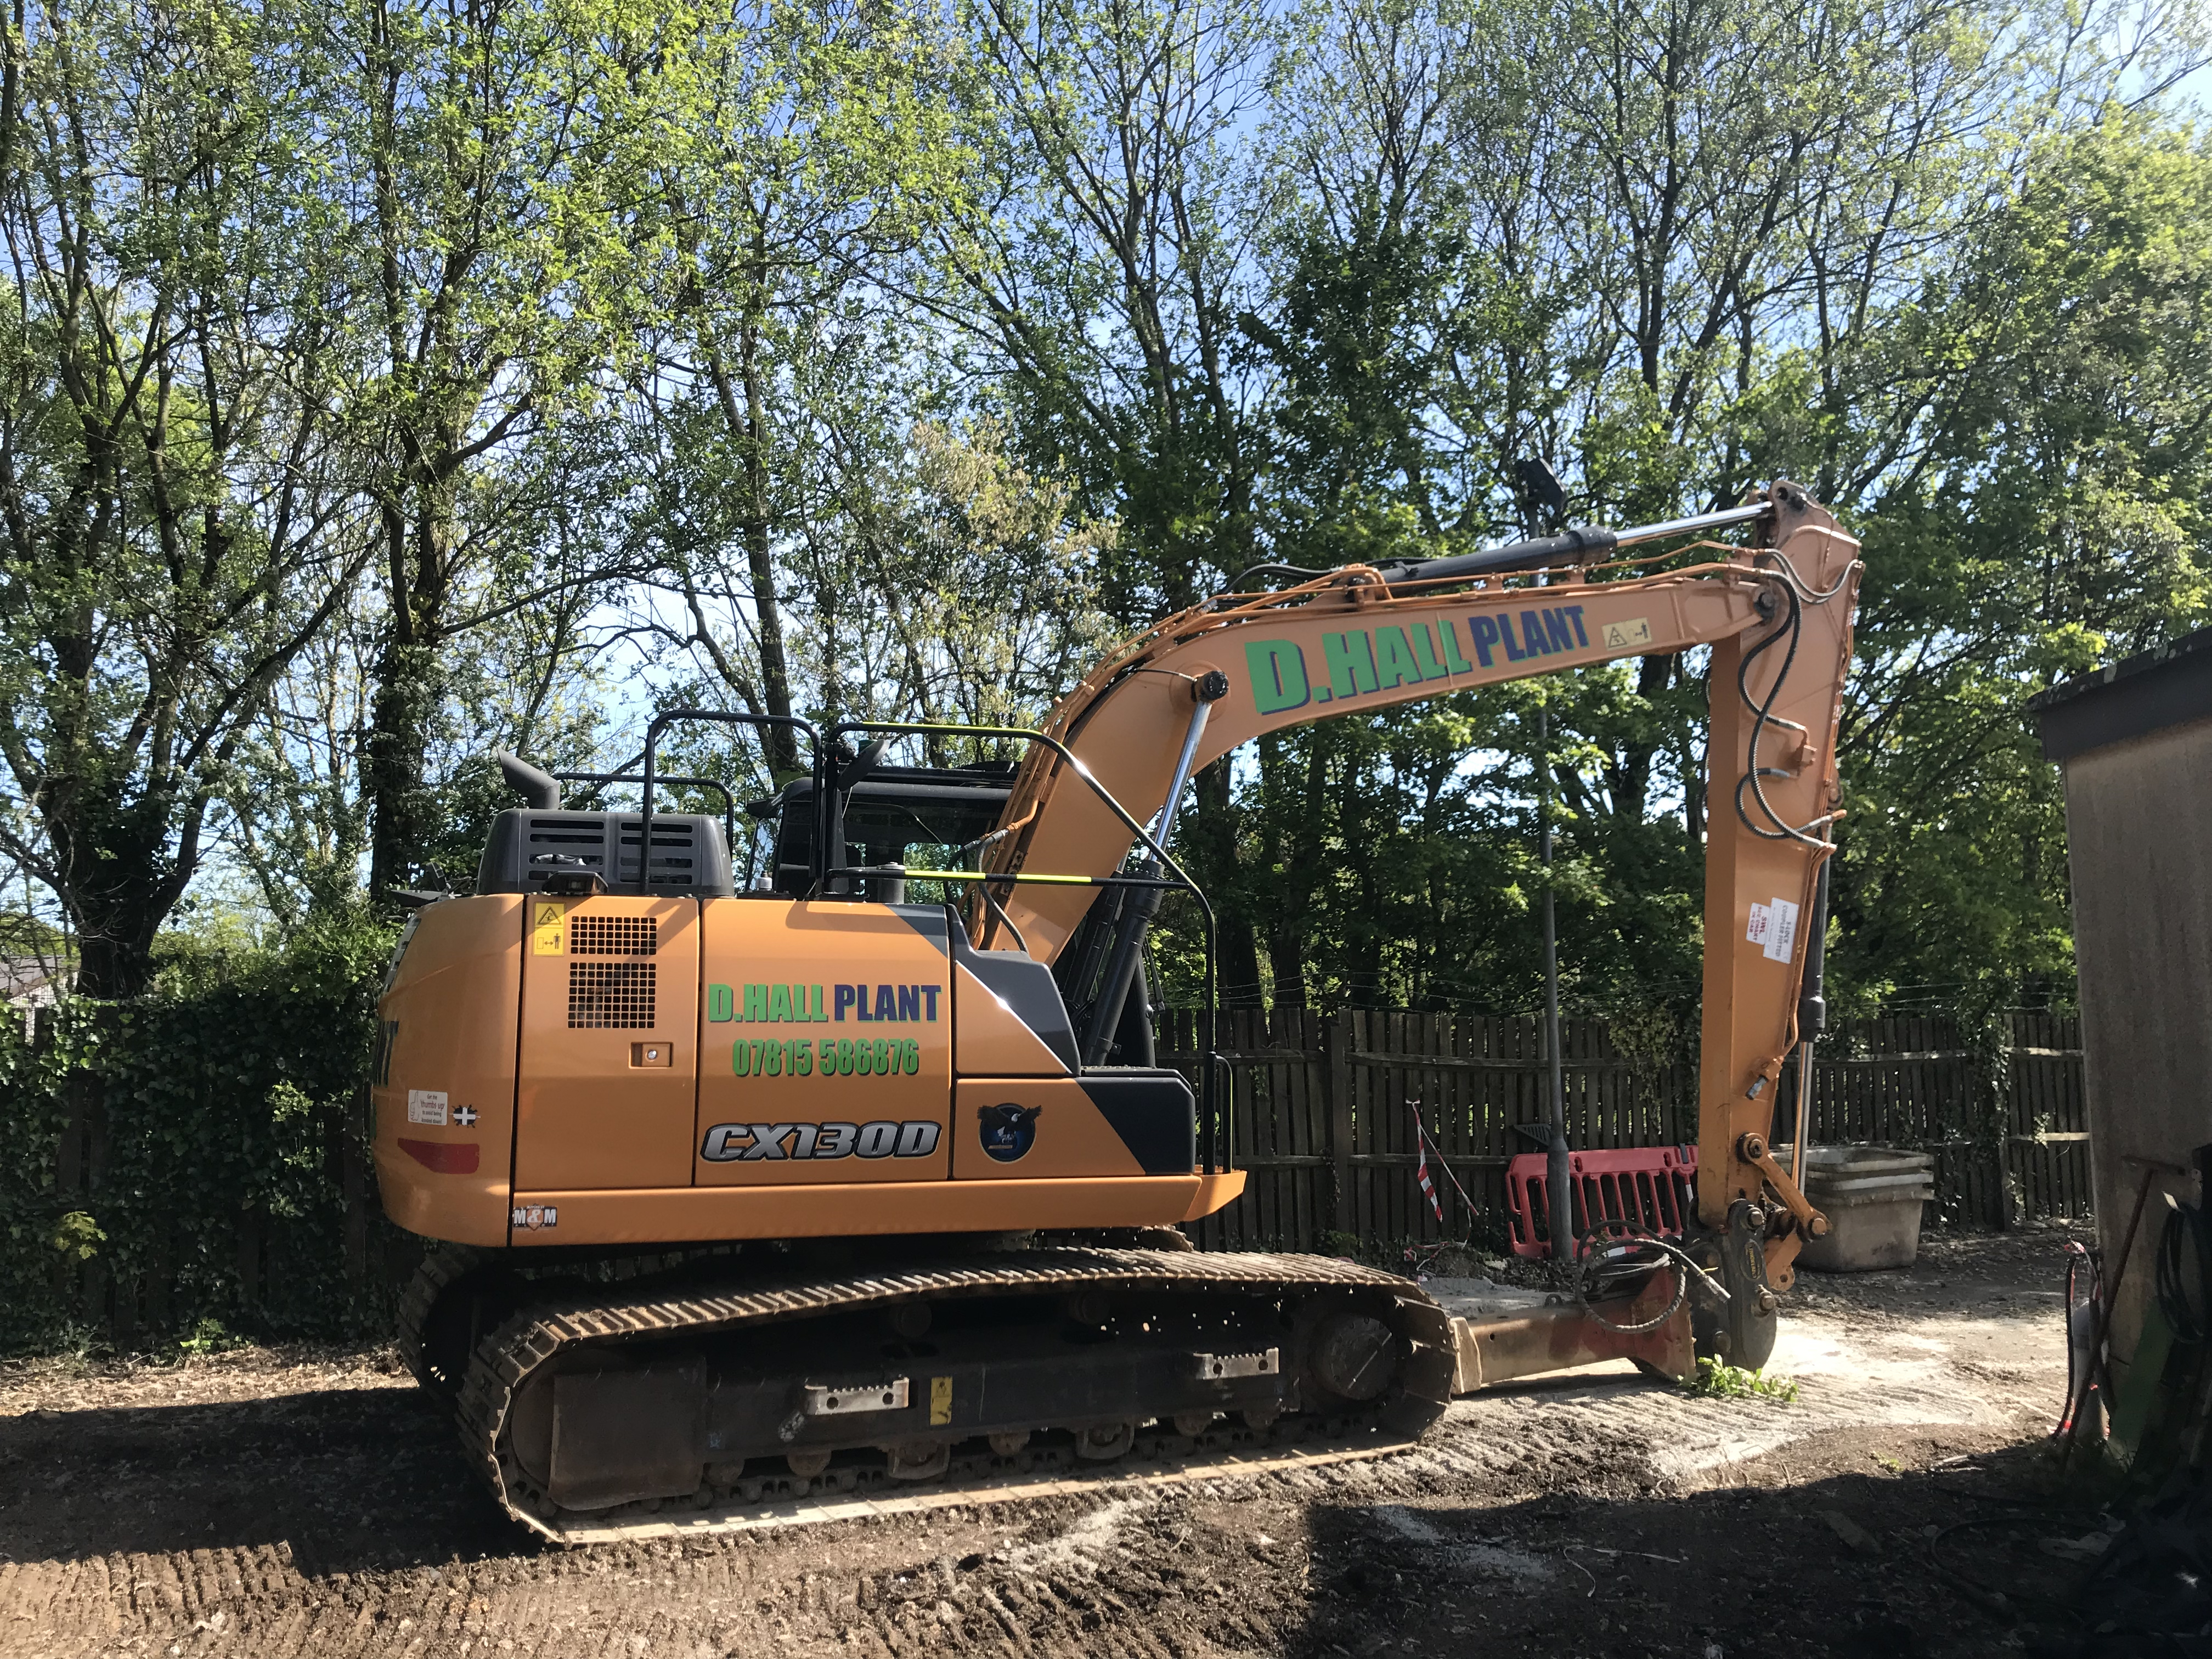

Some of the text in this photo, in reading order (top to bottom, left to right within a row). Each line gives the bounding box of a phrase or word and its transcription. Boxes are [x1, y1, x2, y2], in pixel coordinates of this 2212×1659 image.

[1245, 605, 1589, 715] D.HALL PLANT
[708, 984, 943, 1023] D.HALL PLANT
[733, 1039, 919, 1076] 07815 586876
[700, 1120, 943, 1163] CX130D
